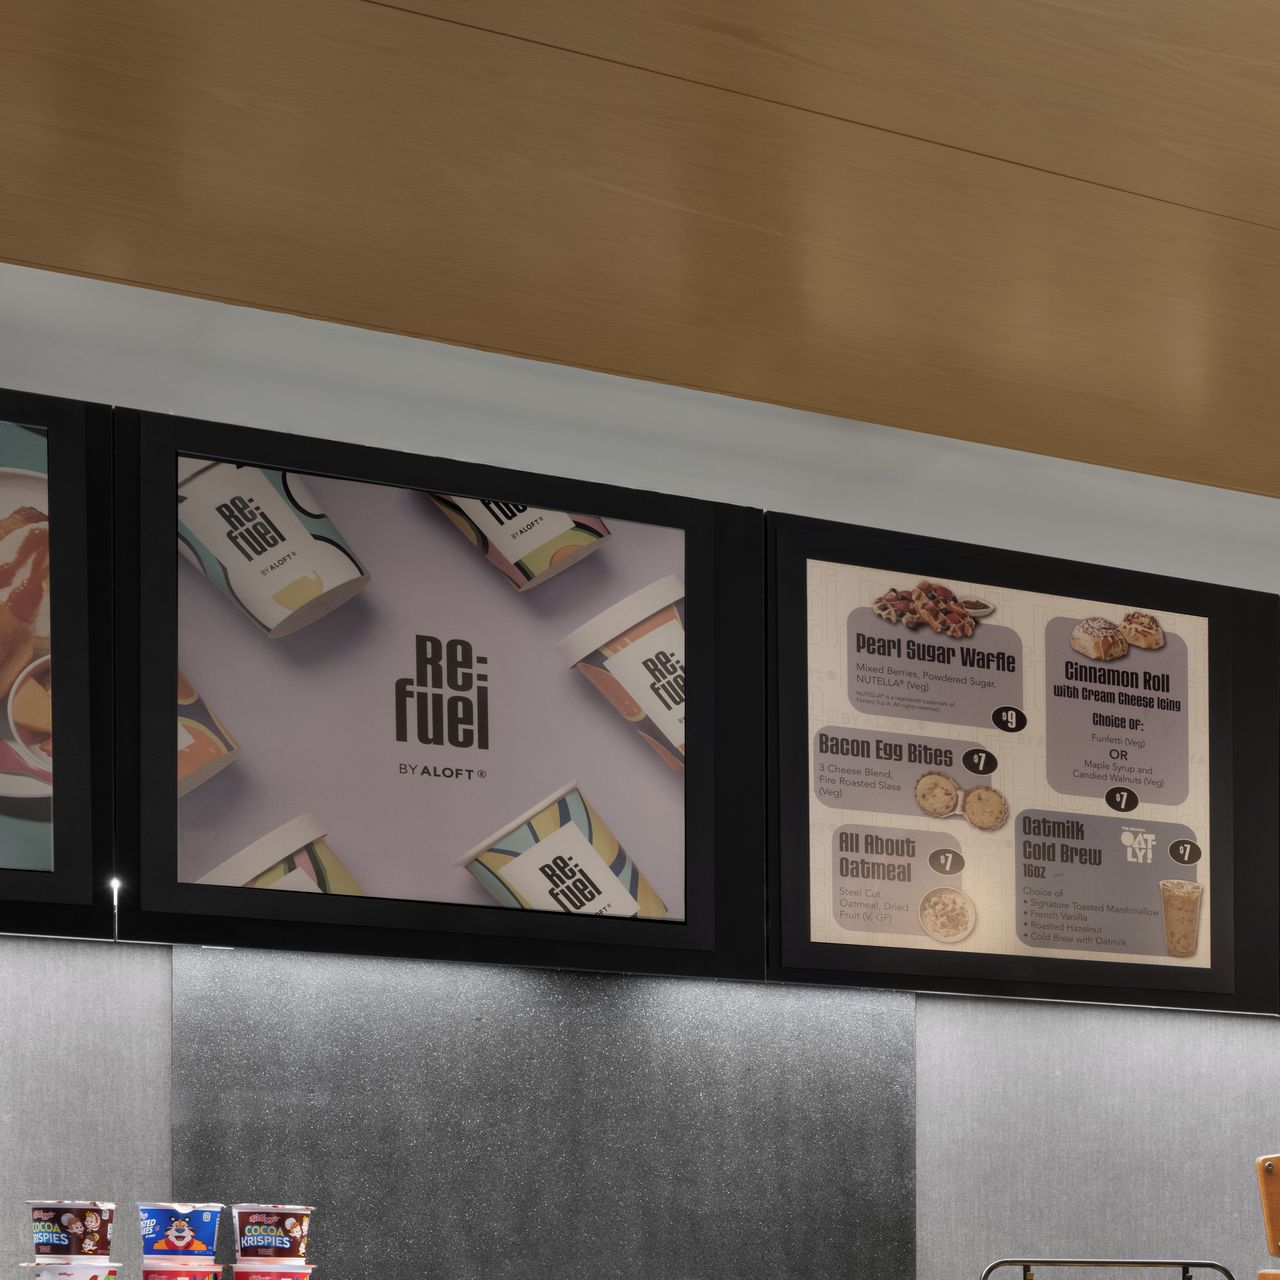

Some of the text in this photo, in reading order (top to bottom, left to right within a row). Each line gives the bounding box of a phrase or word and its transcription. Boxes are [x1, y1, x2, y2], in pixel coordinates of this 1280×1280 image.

[215, 496, 260, 533] Re:
[226, 511, 287, 562] fuel
[856, 633, 1016, 673] Pearl Sugar Waffle
[416, 634, 488, 692] Re:
[642, 651, 681, 683] Re:
[856, 663, 996, 689] Mixed Berries, Powdered Sugar,
[1065, 661, 1170, 693] Cinnamon Roll
[907, 682, 929, 693] (Veg)
[1053, 684, 1181, 712] with Cream Cheese Icing
[395, 678, 489, 750] fuel
[1002, 710, 1016, 728] $9
[1093, 713, 1126, 729] Choice
[819, 733, 953, 767] Bacon Egg Bites
[1091, 734, 1146, 748] Funfetti (Veg)
[973, 753, 986, 771] $7
[1110, 749, 1128, 761] OR
[399, 763, 418, 775] BY
[819, 763, 893, 780] 3 Cheese Blend,
[1084, 759, 1152, 774] Maple Syrup and
[819, 776, 836, 786] Fire
[839, 778, 876, 789] Roasted
[1072, 769, 1164, 789] Candied Walnuts (Veg)
[819, 787, 843, 799] (Veg)
[1115, 792, 1127, 809] $7
[1022, 816, 1085, 840] Oatmilk
[839, 831, 916, 858] All About
[1022, 841, 1102, 866] Cold Brew
[1179, 844, 1190, 861] $7
[839, 857, 912, 883] Oatmeal
[940, 853, 952, 871] $7
[539, 855, 579, 889] Re:
[549, 868, 602, 913] fuel
[839, 887, 881, 898] Steel Cut
[1023, 887, 1052, 897] Choice
[1031, 899, 1159, 917] Signature Toasted Marshmallow
[1031, 910, 1087, 922] French Vanilla
[1031, 921, 1102, 934] Roasted Hazelnut
[1031, 932, 1127, 947] Cold Brew with Oatmilk
[245, 1225, 284, 1236] COCOA
[241, 1234, 291, 1248] KRISPIES
